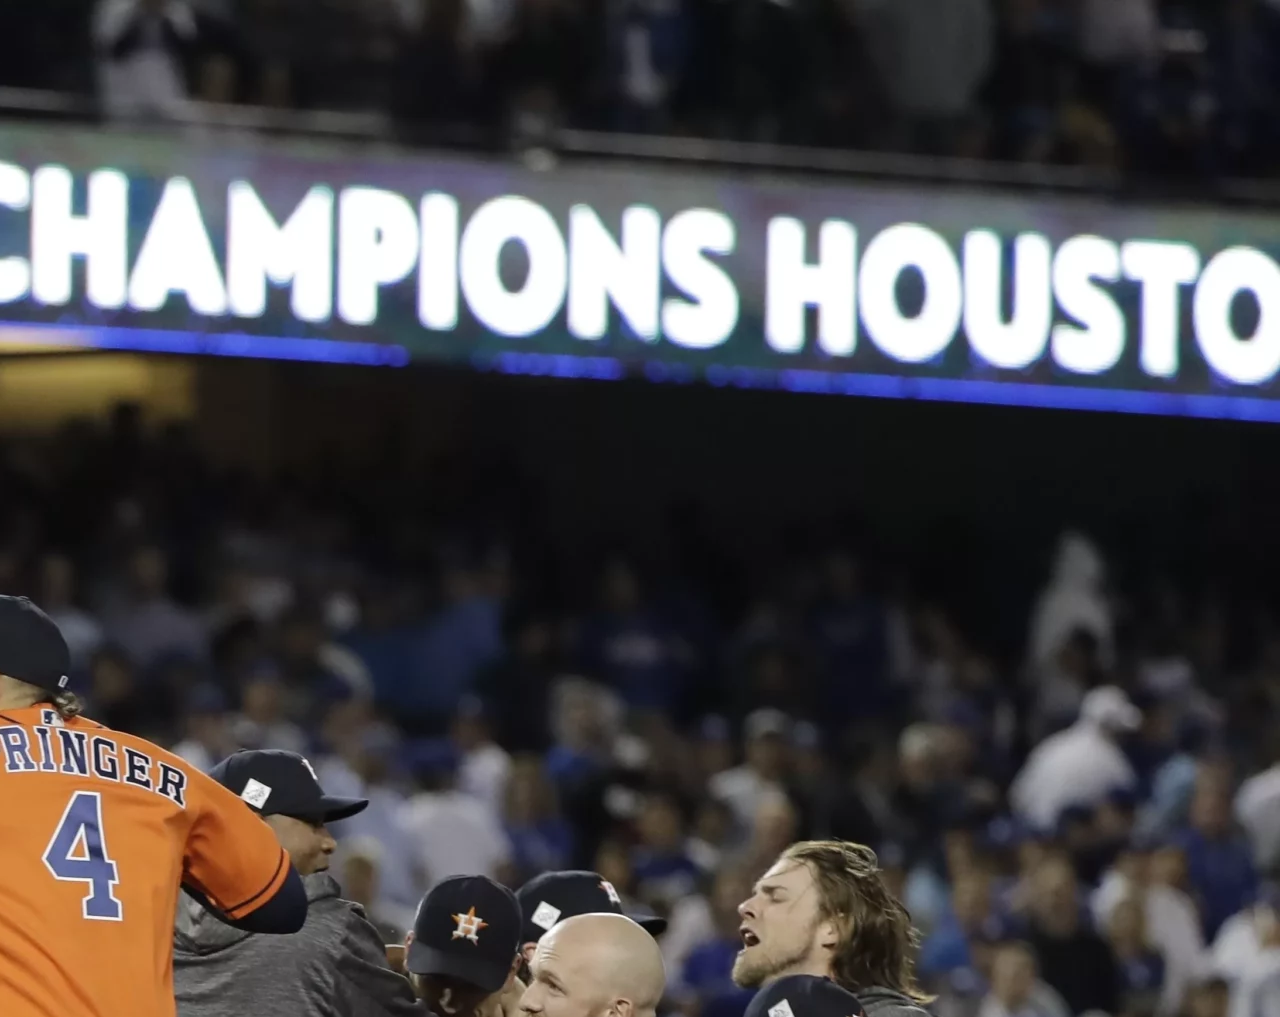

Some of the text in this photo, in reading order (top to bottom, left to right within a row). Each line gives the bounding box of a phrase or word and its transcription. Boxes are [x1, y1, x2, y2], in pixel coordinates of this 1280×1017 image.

[765, 216, 1280, 385] HOUSTO
[41, 790, 123, 922] 4
[452, 912, 483, 941] H
